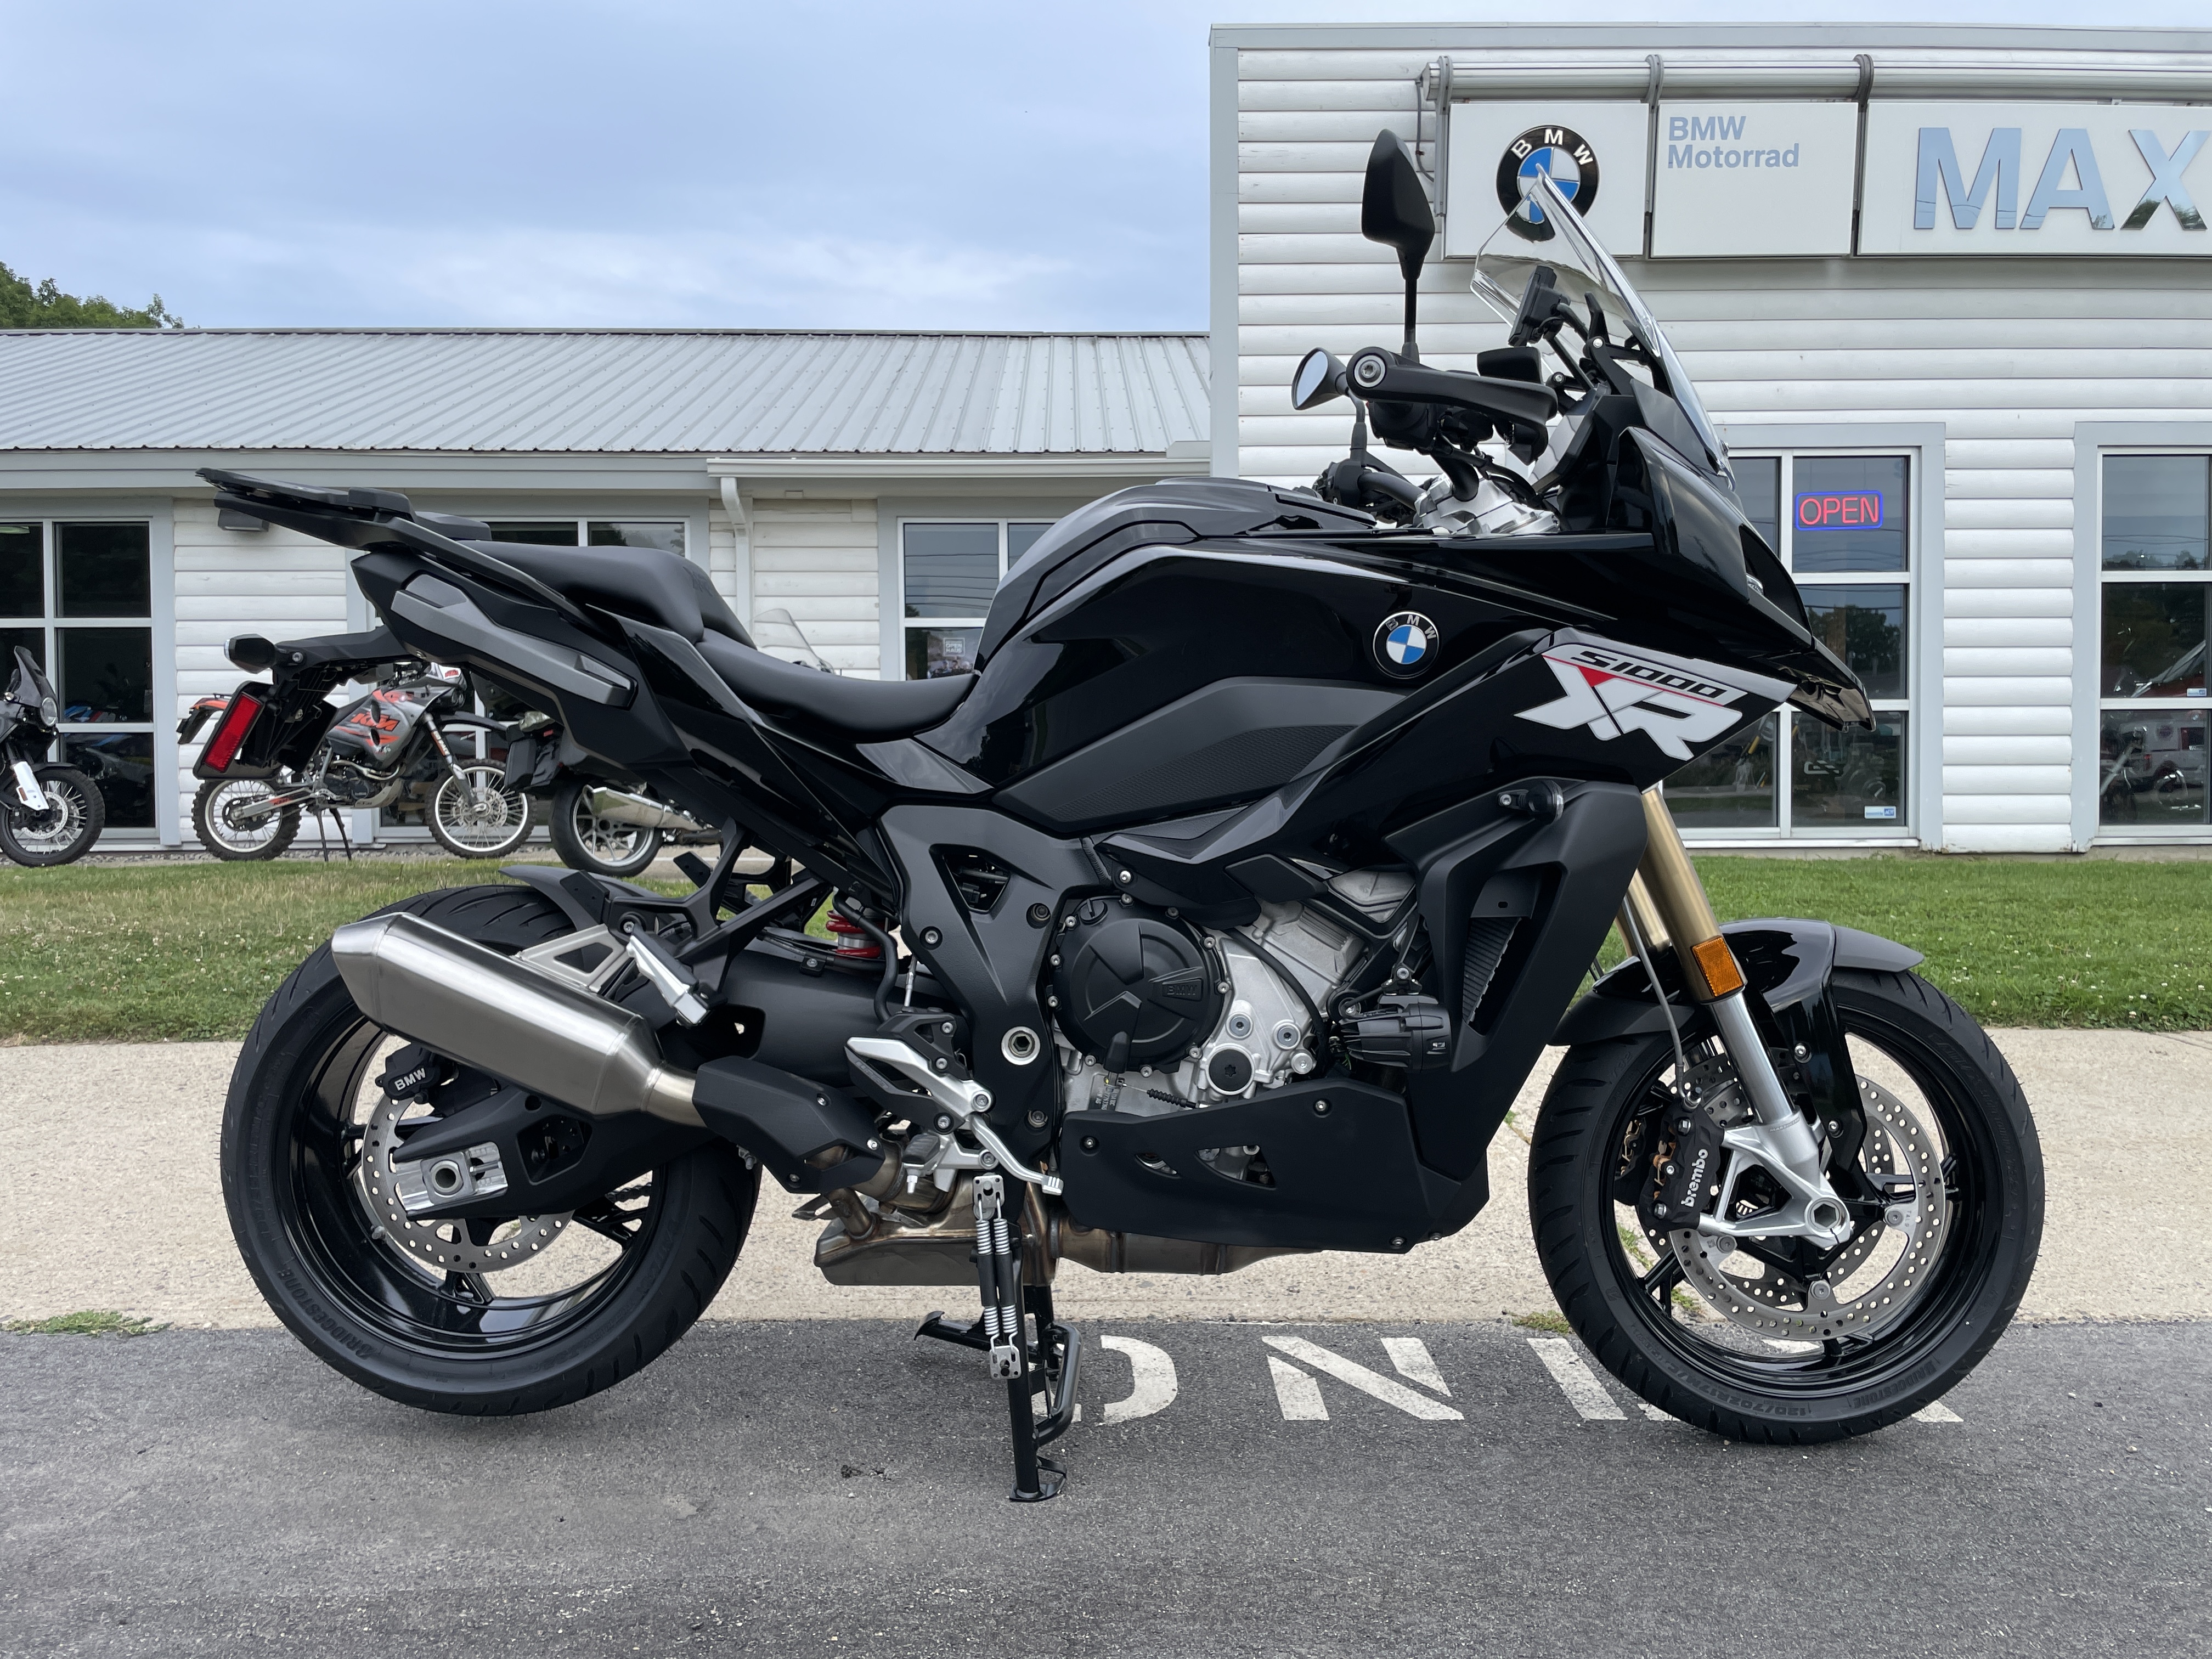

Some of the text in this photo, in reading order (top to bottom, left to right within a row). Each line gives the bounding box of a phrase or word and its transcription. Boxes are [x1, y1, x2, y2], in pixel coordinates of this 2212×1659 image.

[1510, 128, 1593, 165] BMW
[1669, 116, 1747, 141] BMW
[1668, 143, 1799, 168] Motorrad
[1914, 127, 2211, 230] MAX
[1799, 496, 1878, 525] OPEN
[1385, 614, 1437, 640] BMW
[1570, 650, 1727, 698] S1000
[1513, 656, 1743, 761] XR
[1166, 985, 1197, 995] BMW
[394, 1068, 426, 1091] BMW
[1680, 1149, 1708, 1207] brembo
[277, 1267, 374, 1359] BRIDGESTONE
[1852, 1358, 1938, 1409] BRIDGESTONE
